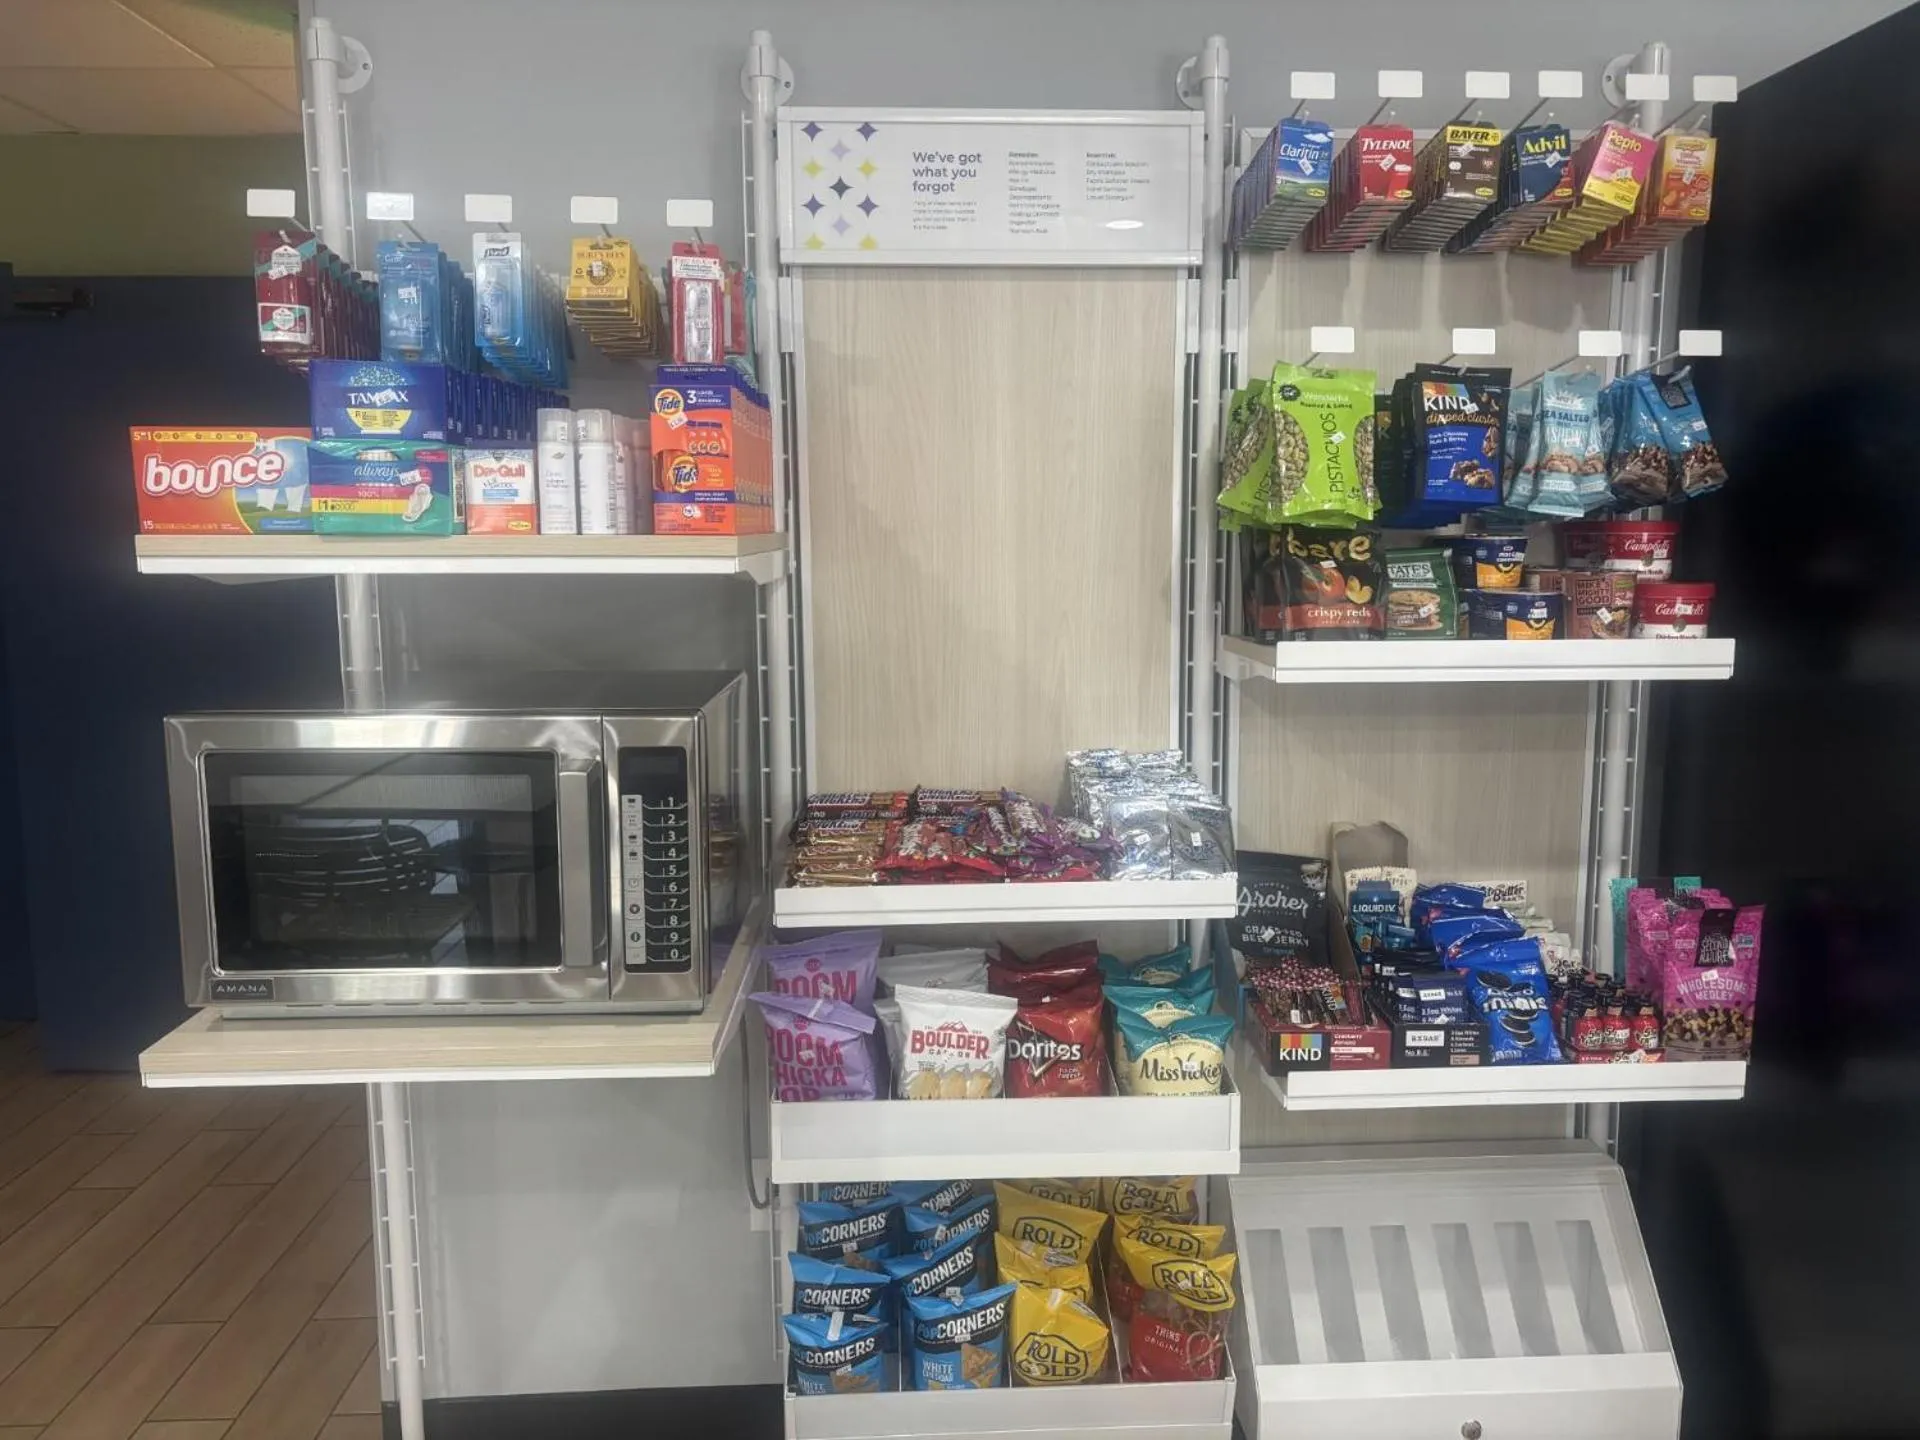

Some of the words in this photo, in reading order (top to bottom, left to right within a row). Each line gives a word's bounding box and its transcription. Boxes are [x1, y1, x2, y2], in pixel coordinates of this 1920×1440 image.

[1450, 129, 1489, 140] BAYER
[1608, 130, 1642, 153] Pepto
[1280, 143, 1319, 160] Claritin
[1361, 137, 1412, 152] TYLENOL
[1523, 134, 1567, 154] Advil
[912, 151, 955, 163] We've
[958, 152, 982, 166] got
[912, 166, 949, 178] what
[951, 168, 977, 181] you
[912, 181, 955, 195] forgot
[347, 390, 409, 406] TAMAX
[686, 389, 697, 404] 3
[1424, 395, 1471, 411] KIND
[657, 396, 680, 413] Tide
[146, 453, 283, 494] bounce
[354, 462, 400, 481] always
[143, 520, 154, 530] 15
[1287, 527, 1372, 561] bare
[1576, 595, 1611, 604] GOOD
[1307, 607, 1343, 620] crispy
[1346, 606, 1372, 618] reds
[667, 797, 674, 807] 1
[667, 814, 676, 824] 2
[667, 831, 676, 841] 3
[668, 848, 677, 858] 4
[668, 865, 677, 875] 5
[668, 882, 678, 892] 6
[669, 899, 678, 909] 7
[1237, 886, 1309, 918] Archer
[669, 915, 678, 926] 8
[670, 932, 679, 942] 9
[1274, 935, 1309, 947] JERKY
[670, 949, 679, 959] 0
[216, 984, 268, 993] AMANA
[1677, 977, 1748, 996] WHOLESOME
[1695, 990, 1734, 1001] MEDLEY
[911, 1029, 990, 1060] BOULDER
[1008, 1038, 1081, 1061] Doritos
[928, 1048, 971, 1058] CAON
[1279, 1047, 1322, 1061] KIND
[775, 1063, 848, 1087] HICKA
[1139, 1058, 1179, 1082] Miss
[1021, 1222, 1078, 1251] ROLD
[1137, 1230, 1194, 1252] ROLD
[1026, 1337, 1081, 1365] ROLD
[1144, 1336, 1184, 1356] ORIGINAL
[923, 1359, 953, 1374] WHITE
[1016, 1359, 1082, 1377] GOLD
